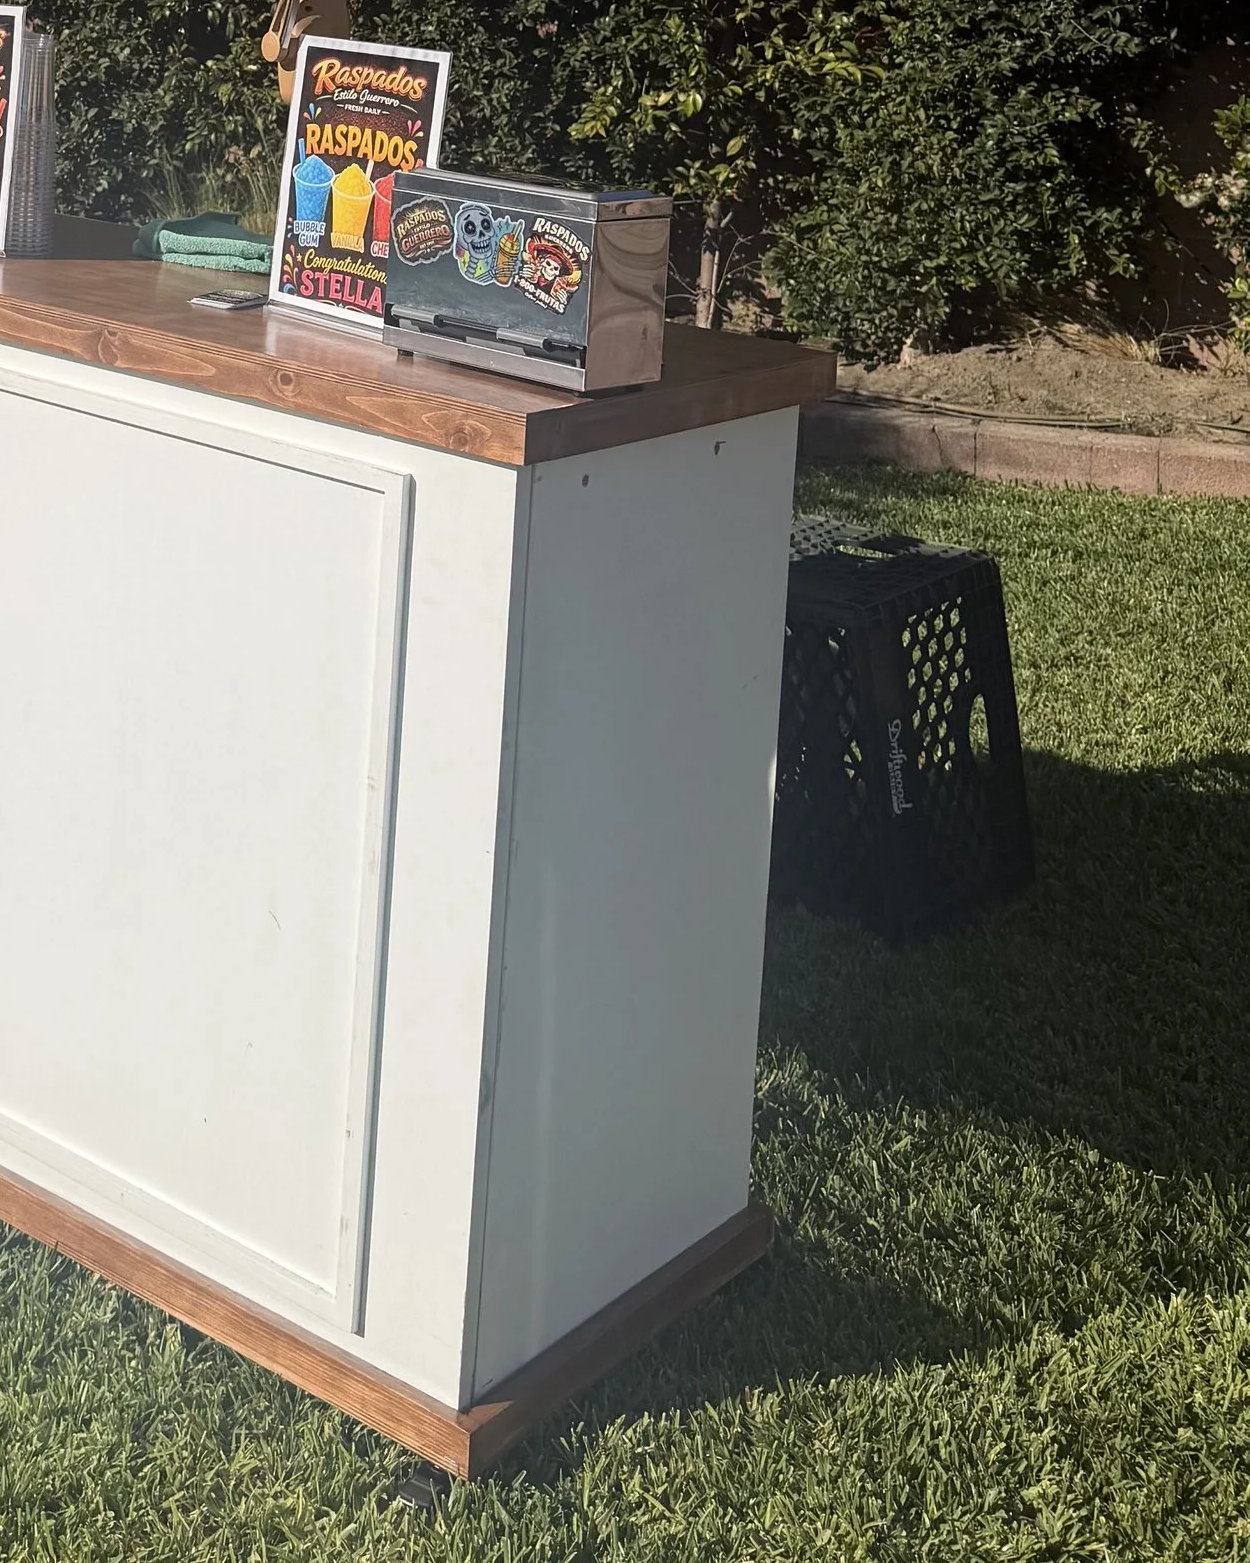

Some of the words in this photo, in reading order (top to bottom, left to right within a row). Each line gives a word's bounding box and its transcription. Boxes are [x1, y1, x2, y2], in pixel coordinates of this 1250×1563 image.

[312, 58, 427, 101] Raspados
[333, 88, 358, 101] Estilo
[359, 89, 400, 107] Guerrero
[344, 104, 363, 113] FRESH
[364, 106, 381, 115] DAILY
[305, 123, 418, 172] RASPADOS
[294, 221, 326, 235] BUBBLE
[396, 210, 446, 239] RASPADOS
[401, 224, 451, 251] GUERRERO
[299, 234, 319, 247] GUM
[331, 233, 364, 252] VANILLA
[532, 217, 590, 261] RASPADOS
[300, 269, 383, 314] STELLA
[888, 719, 912, 810] Driftwood
